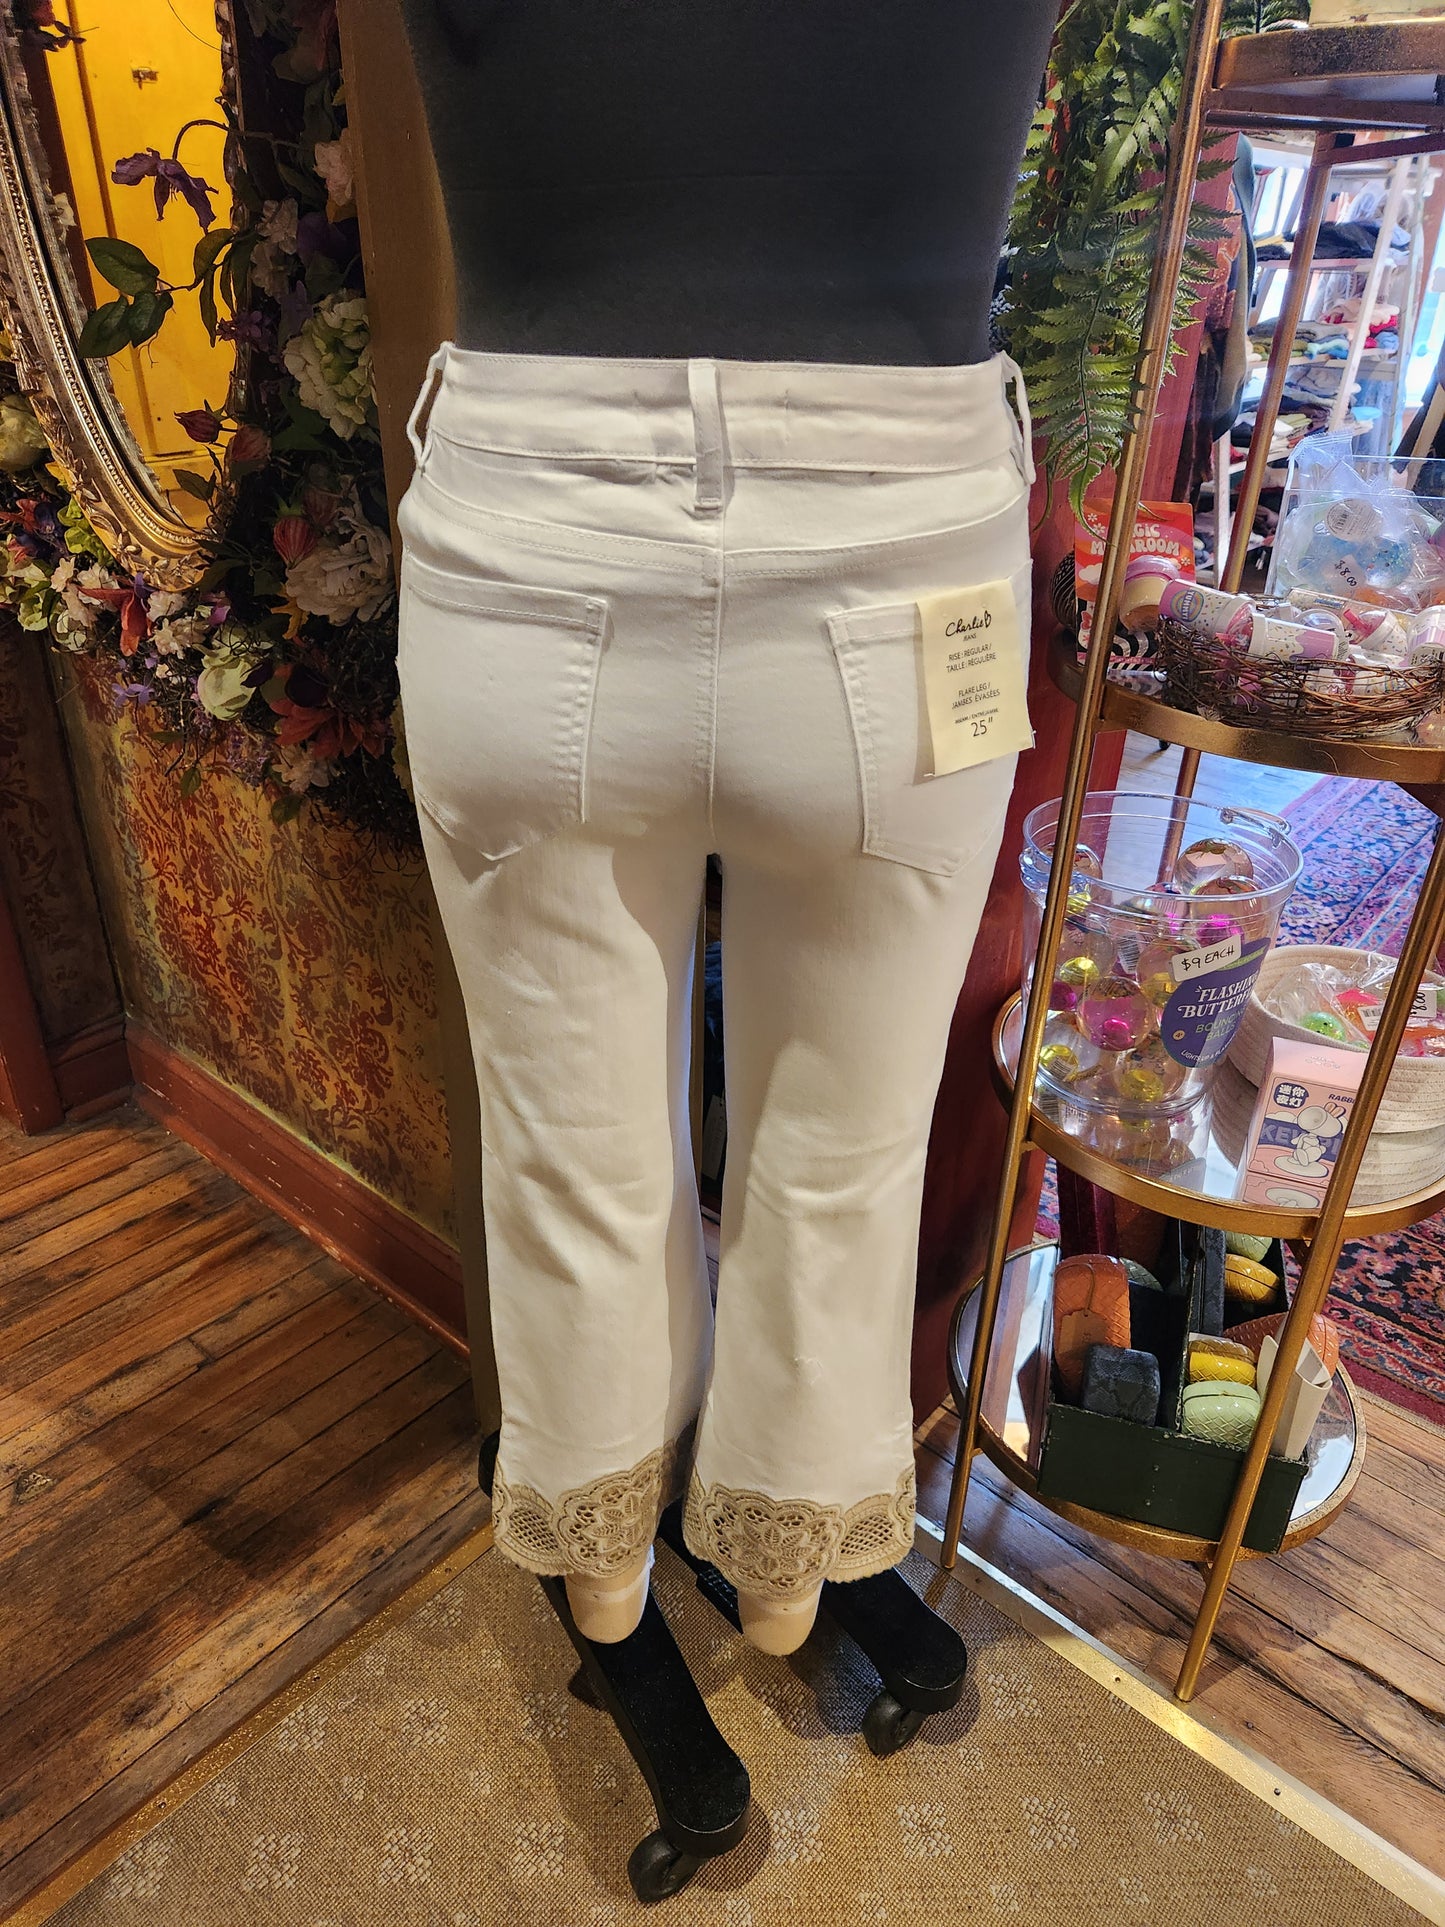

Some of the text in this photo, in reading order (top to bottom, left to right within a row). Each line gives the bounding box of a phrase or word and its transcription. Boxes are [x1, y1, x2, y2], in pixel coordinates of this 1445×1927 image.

[1090, 538, 1179, 556] MROOM
[958, 686, 975, 697] FLARE
[1181, 957, 1201, 971] $9
[1204, 945, 1235, 964] EACH
[1328, 1093, 1355, 1104] RABBI
